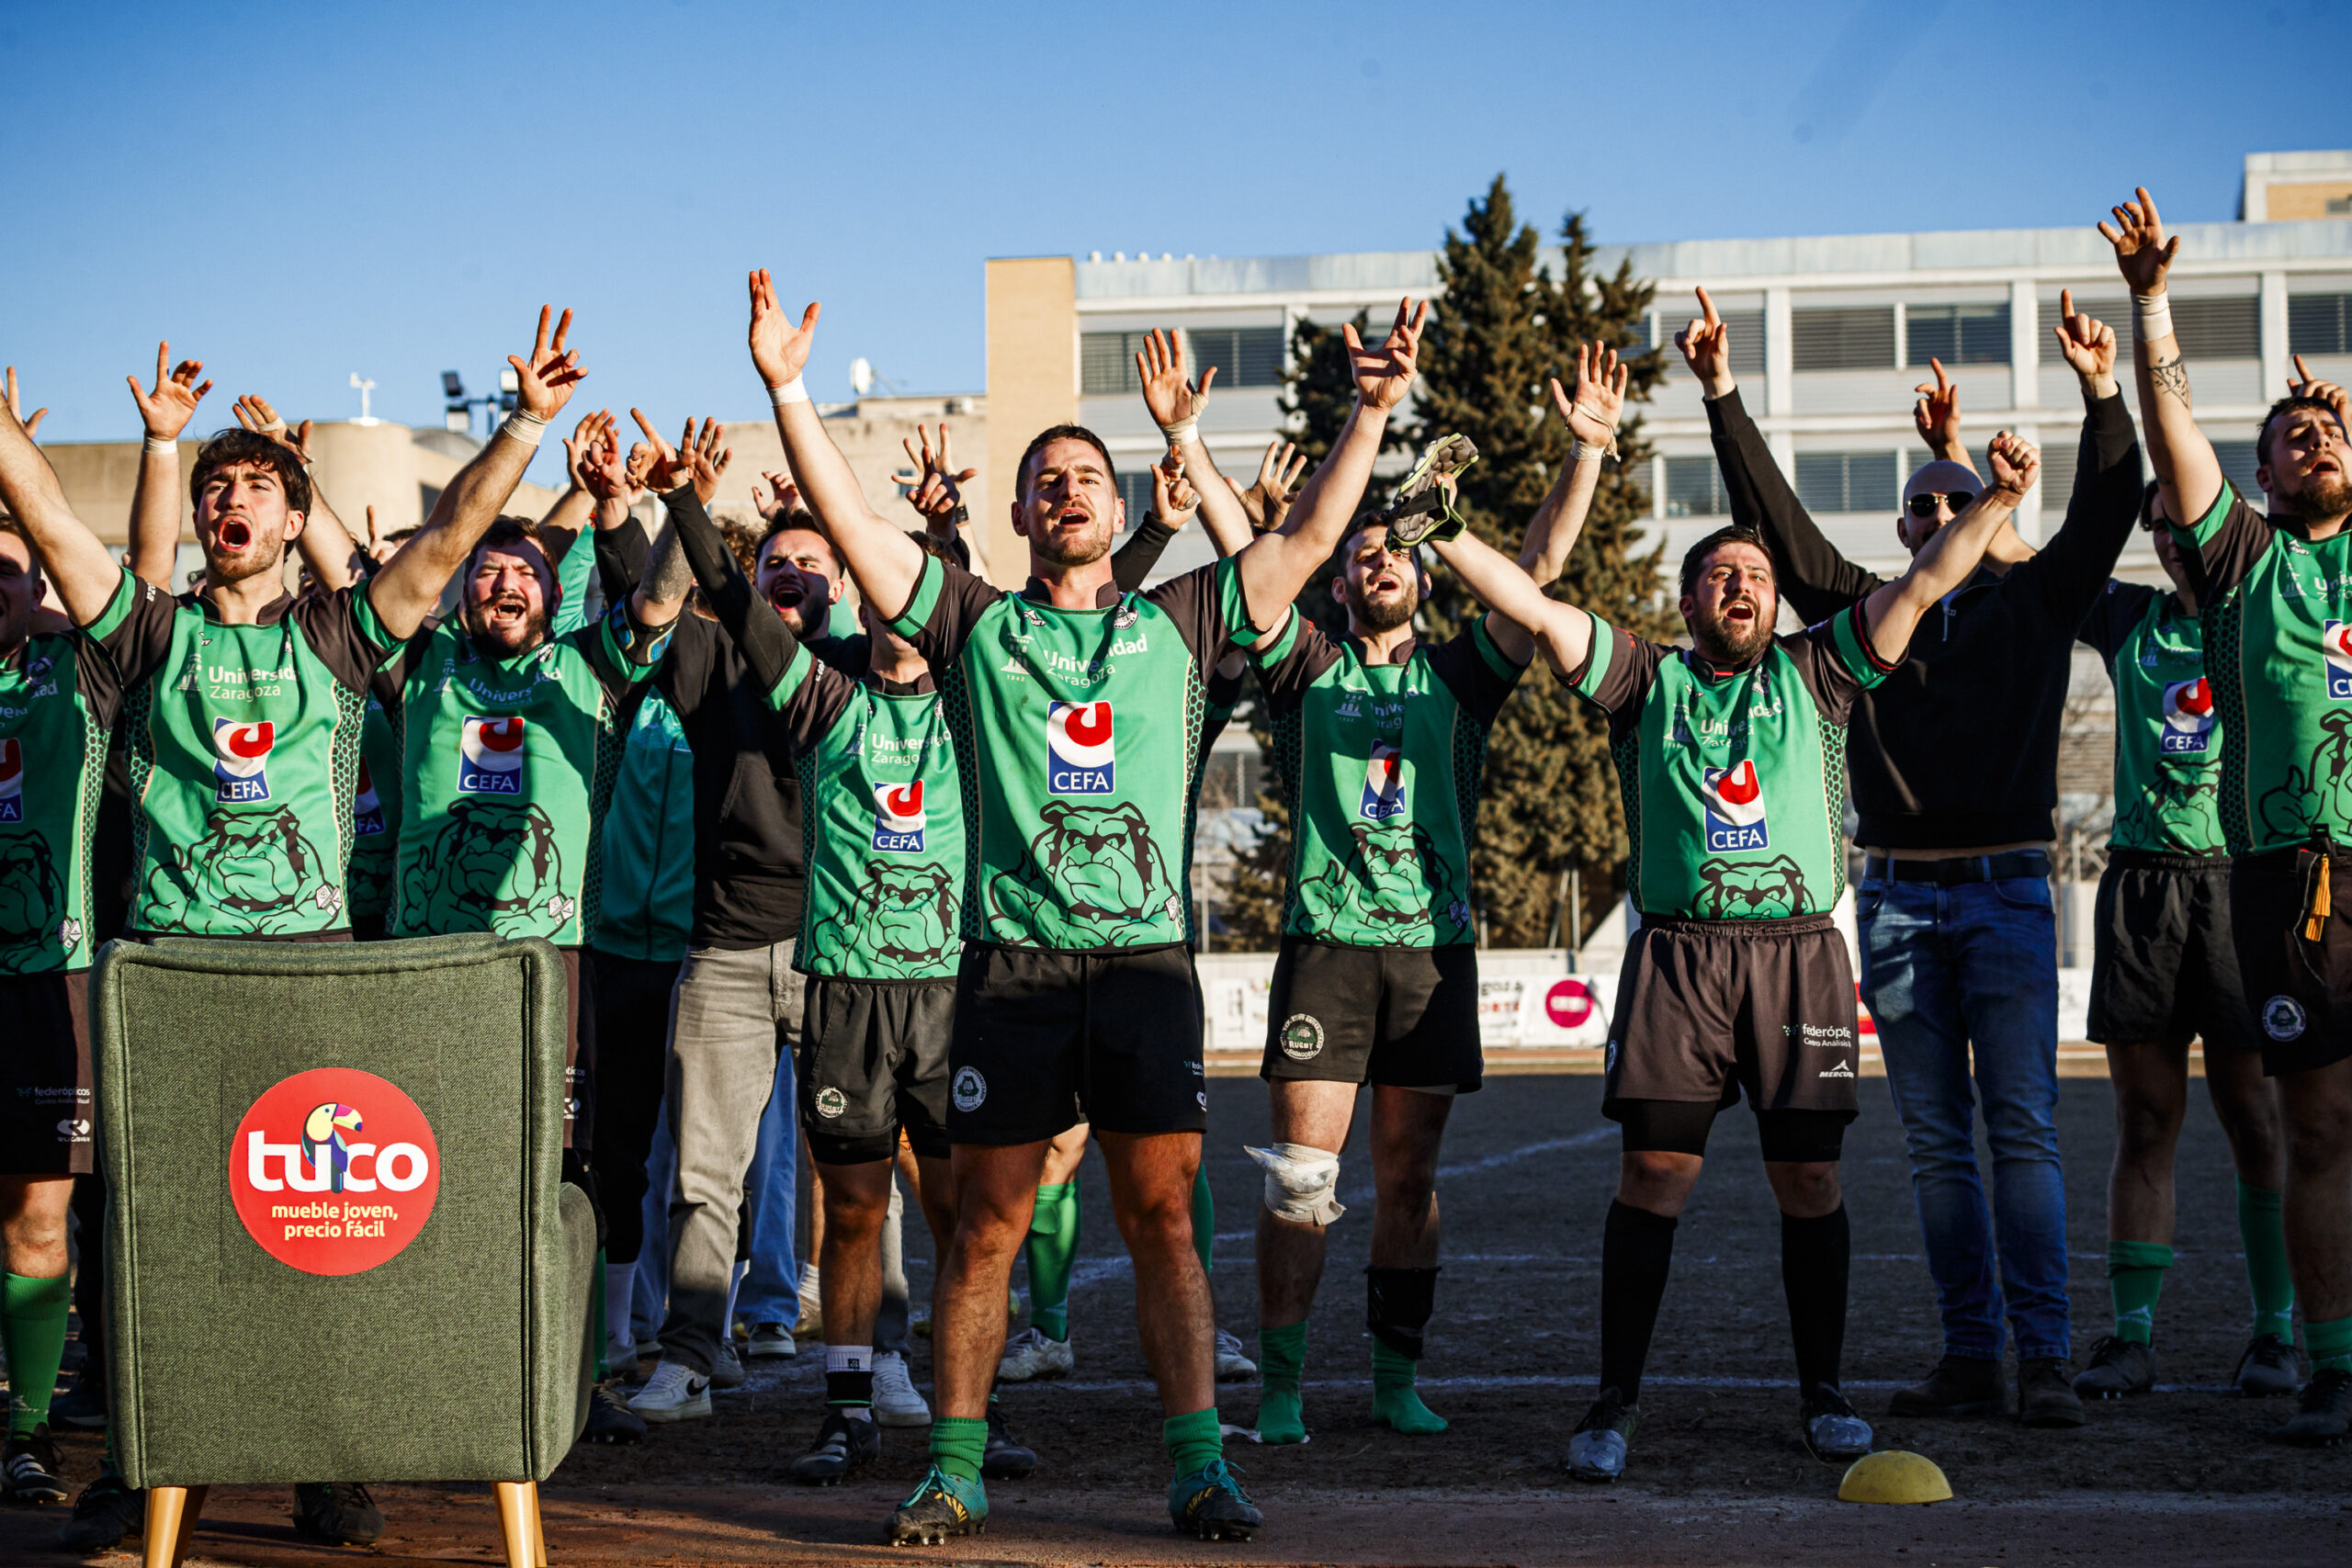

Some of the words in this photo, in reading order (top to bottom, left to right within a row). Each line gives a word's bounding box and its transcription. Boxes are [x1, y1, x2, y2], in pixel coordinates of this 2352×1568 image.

[1046, 664, 1116, 688] Zaragoza
[209, 685, 281, 703] Zaragoza
[2165, 736, 2205, 750] CEFA
[220, 782, 266, 799] CEFA
[464, 773, 515, 791] CEFA
[1054, 772, 1110, 791] CEFA
[876, 835, 921, 851] CEFA
[1711, 829, 1765, 849] CEFA
[247, 1130, 429, 1193] tuco
[271, 1201, 339, 1219] mueble
[341, 1201, 399, 1223] joven,
[284, 1222, 342, 1241] precio
[345, 1220, 385, 1237] fácil
